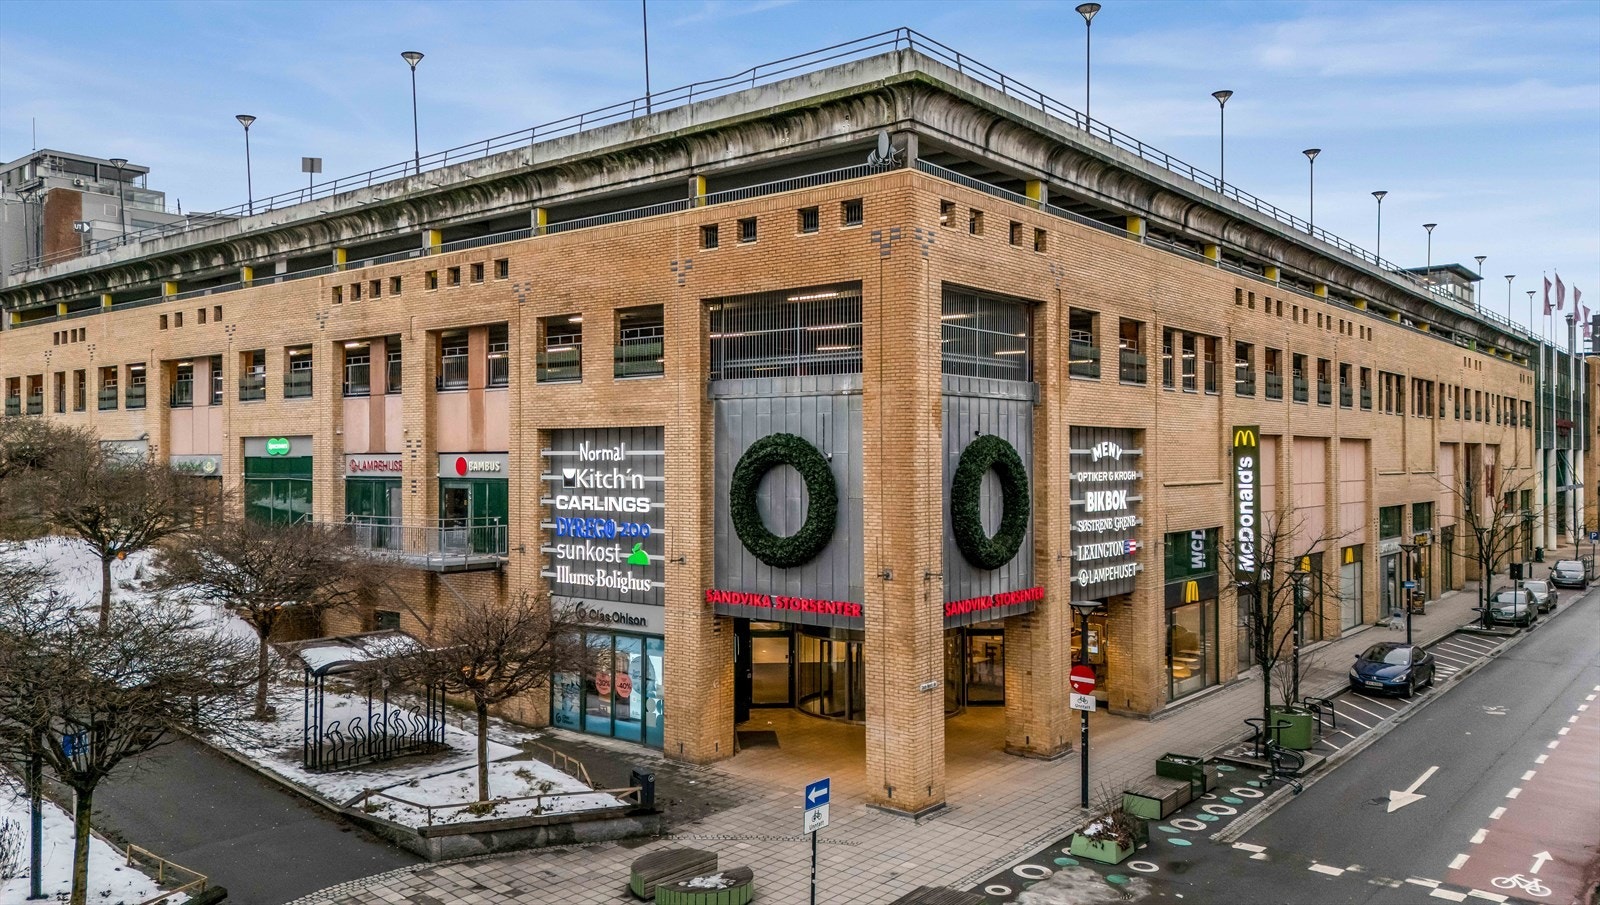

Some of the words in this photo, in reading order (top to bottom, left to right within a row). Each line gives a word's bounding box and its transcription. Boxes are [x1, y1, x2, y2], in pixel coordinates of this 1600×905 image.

[579, 440, 625, 461] Normal
[1091, 441, 1123, 462] MENY
[468, 461, 501, 472] BAMBUS
[1077, 471, 1108, 482] OPTIKER
[1114, 470, 1136, 481] KROGH
[555, 495, 651, 513] CARLINGS
[1238, 456, 1255, 573] McDonald's
[556, 540, 622, 563] sunkost
[1078, 540, 1124, 561] LEXINGTON
[556, 565, 595, 586] Illums
[596, 569, 651, 594] Bolighus
[1088, 563, 1137, 584] LAMPEHUSET
[705, 589, 773, 608] SANDVIKA
[774, 595, 863, 617] STORSENTER
[943, 595, 993, 617] SANDVIKA
[993, 586, 1045, 607] STORSENTER
[589, 608, 611, 622] Clas
[612, 611, 647, 626] Ohlson
